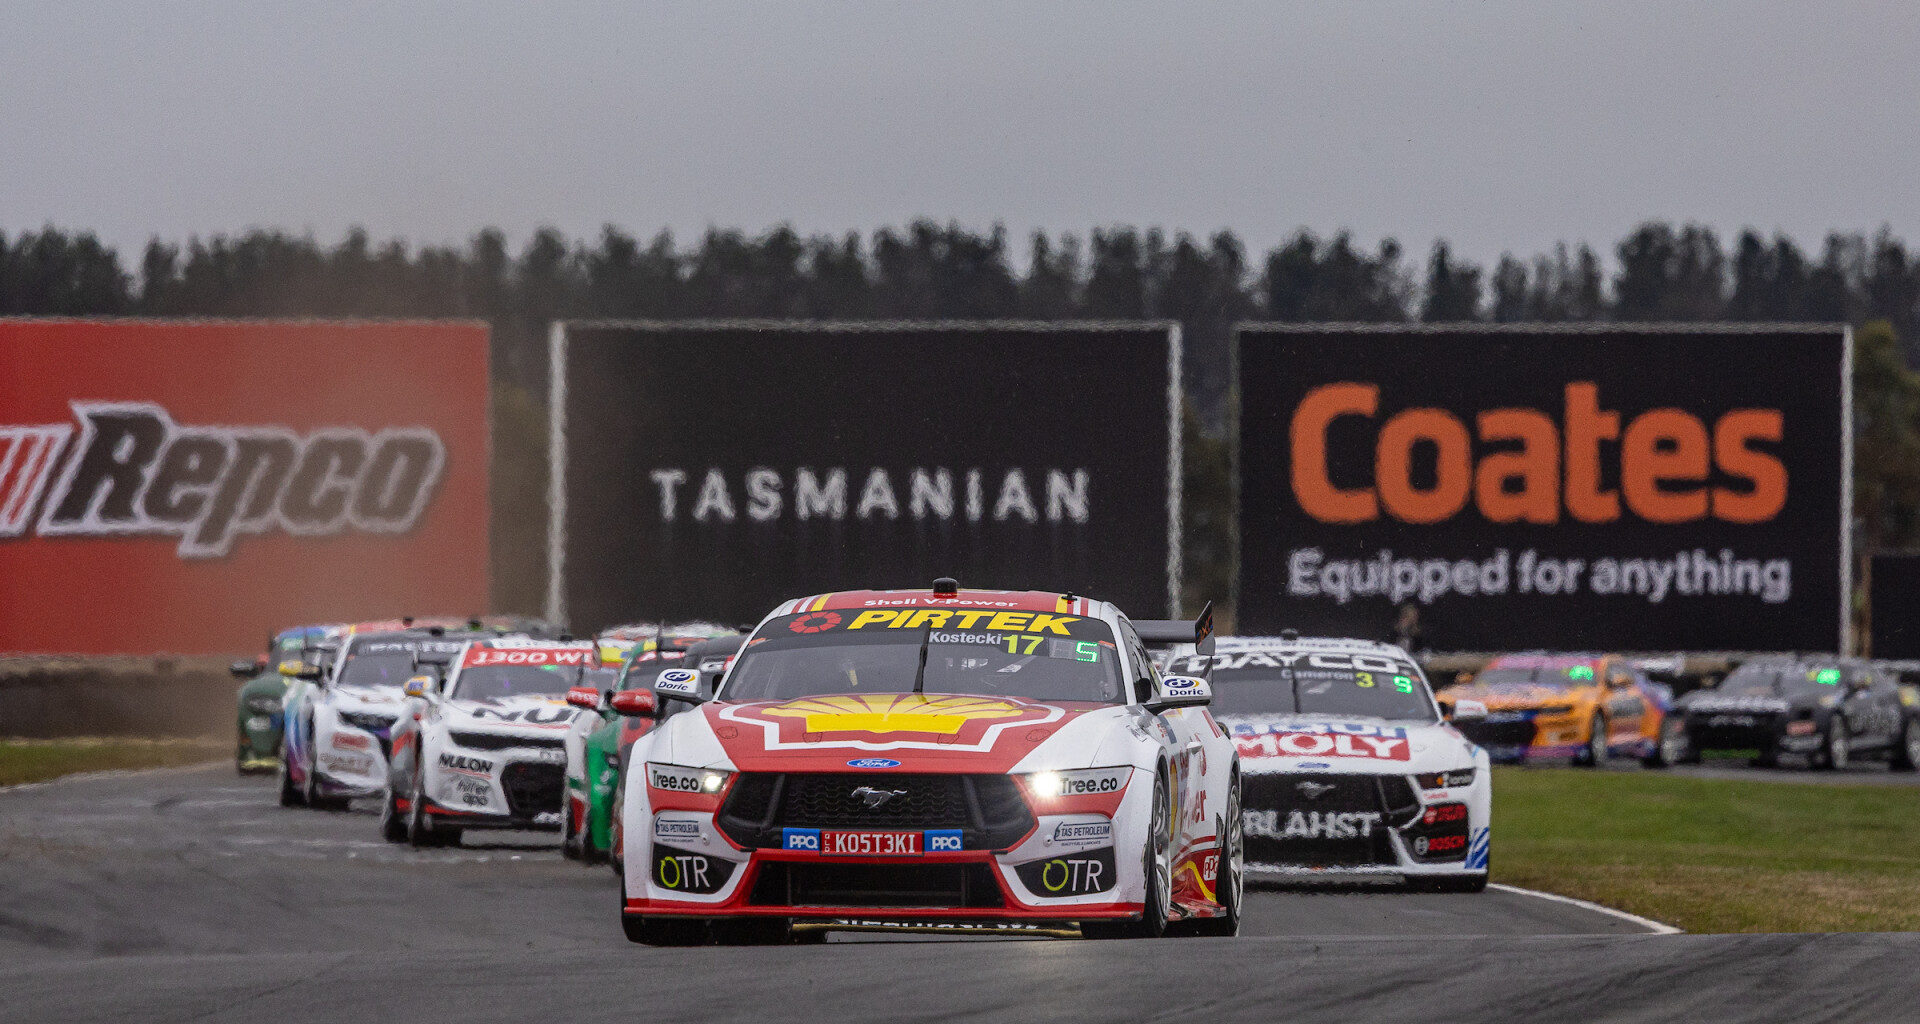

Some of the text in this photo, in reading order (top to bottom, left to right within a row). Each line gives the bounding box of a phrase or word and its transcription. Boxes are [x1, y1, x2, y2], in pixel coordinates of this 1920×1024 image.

[1289, 381, 1788, 525] Coates
[36, 399, 448, 560] Repco
[650, 467, 1091, 523] TASMANIAN
[1288, 548, 1792, 603] Equipped for anything
[864, 597, 1019, 609] Shell V-Power
[846, 609, 1082, 636] PIRTEK
[928, 631, 1044, 656] Kostecki 17
[472, 651, 548, 665] 1300
[1187, 651, 1400, 674] DAYCO
[658, 681, 689, 692] Doric
[1355, 671, 1374, 688] 3
[1169, 688, 1204, 696] Doric
[1230, 733, 1405, 759] MOLY
[438, 752, 495, 773] NULON
[652, 770, 699, 791] Tree.co
[1060, 777, 1118, 794] Tree.co
[788, 834, 819, 849] PPQ
[1061, 825, 1110, 837] TAS PETROLEUM
[931, 836, 962, 850] PPQ
[660, 856, 710, 888] OTR
[1042, 859, 1103, 892] OTR
